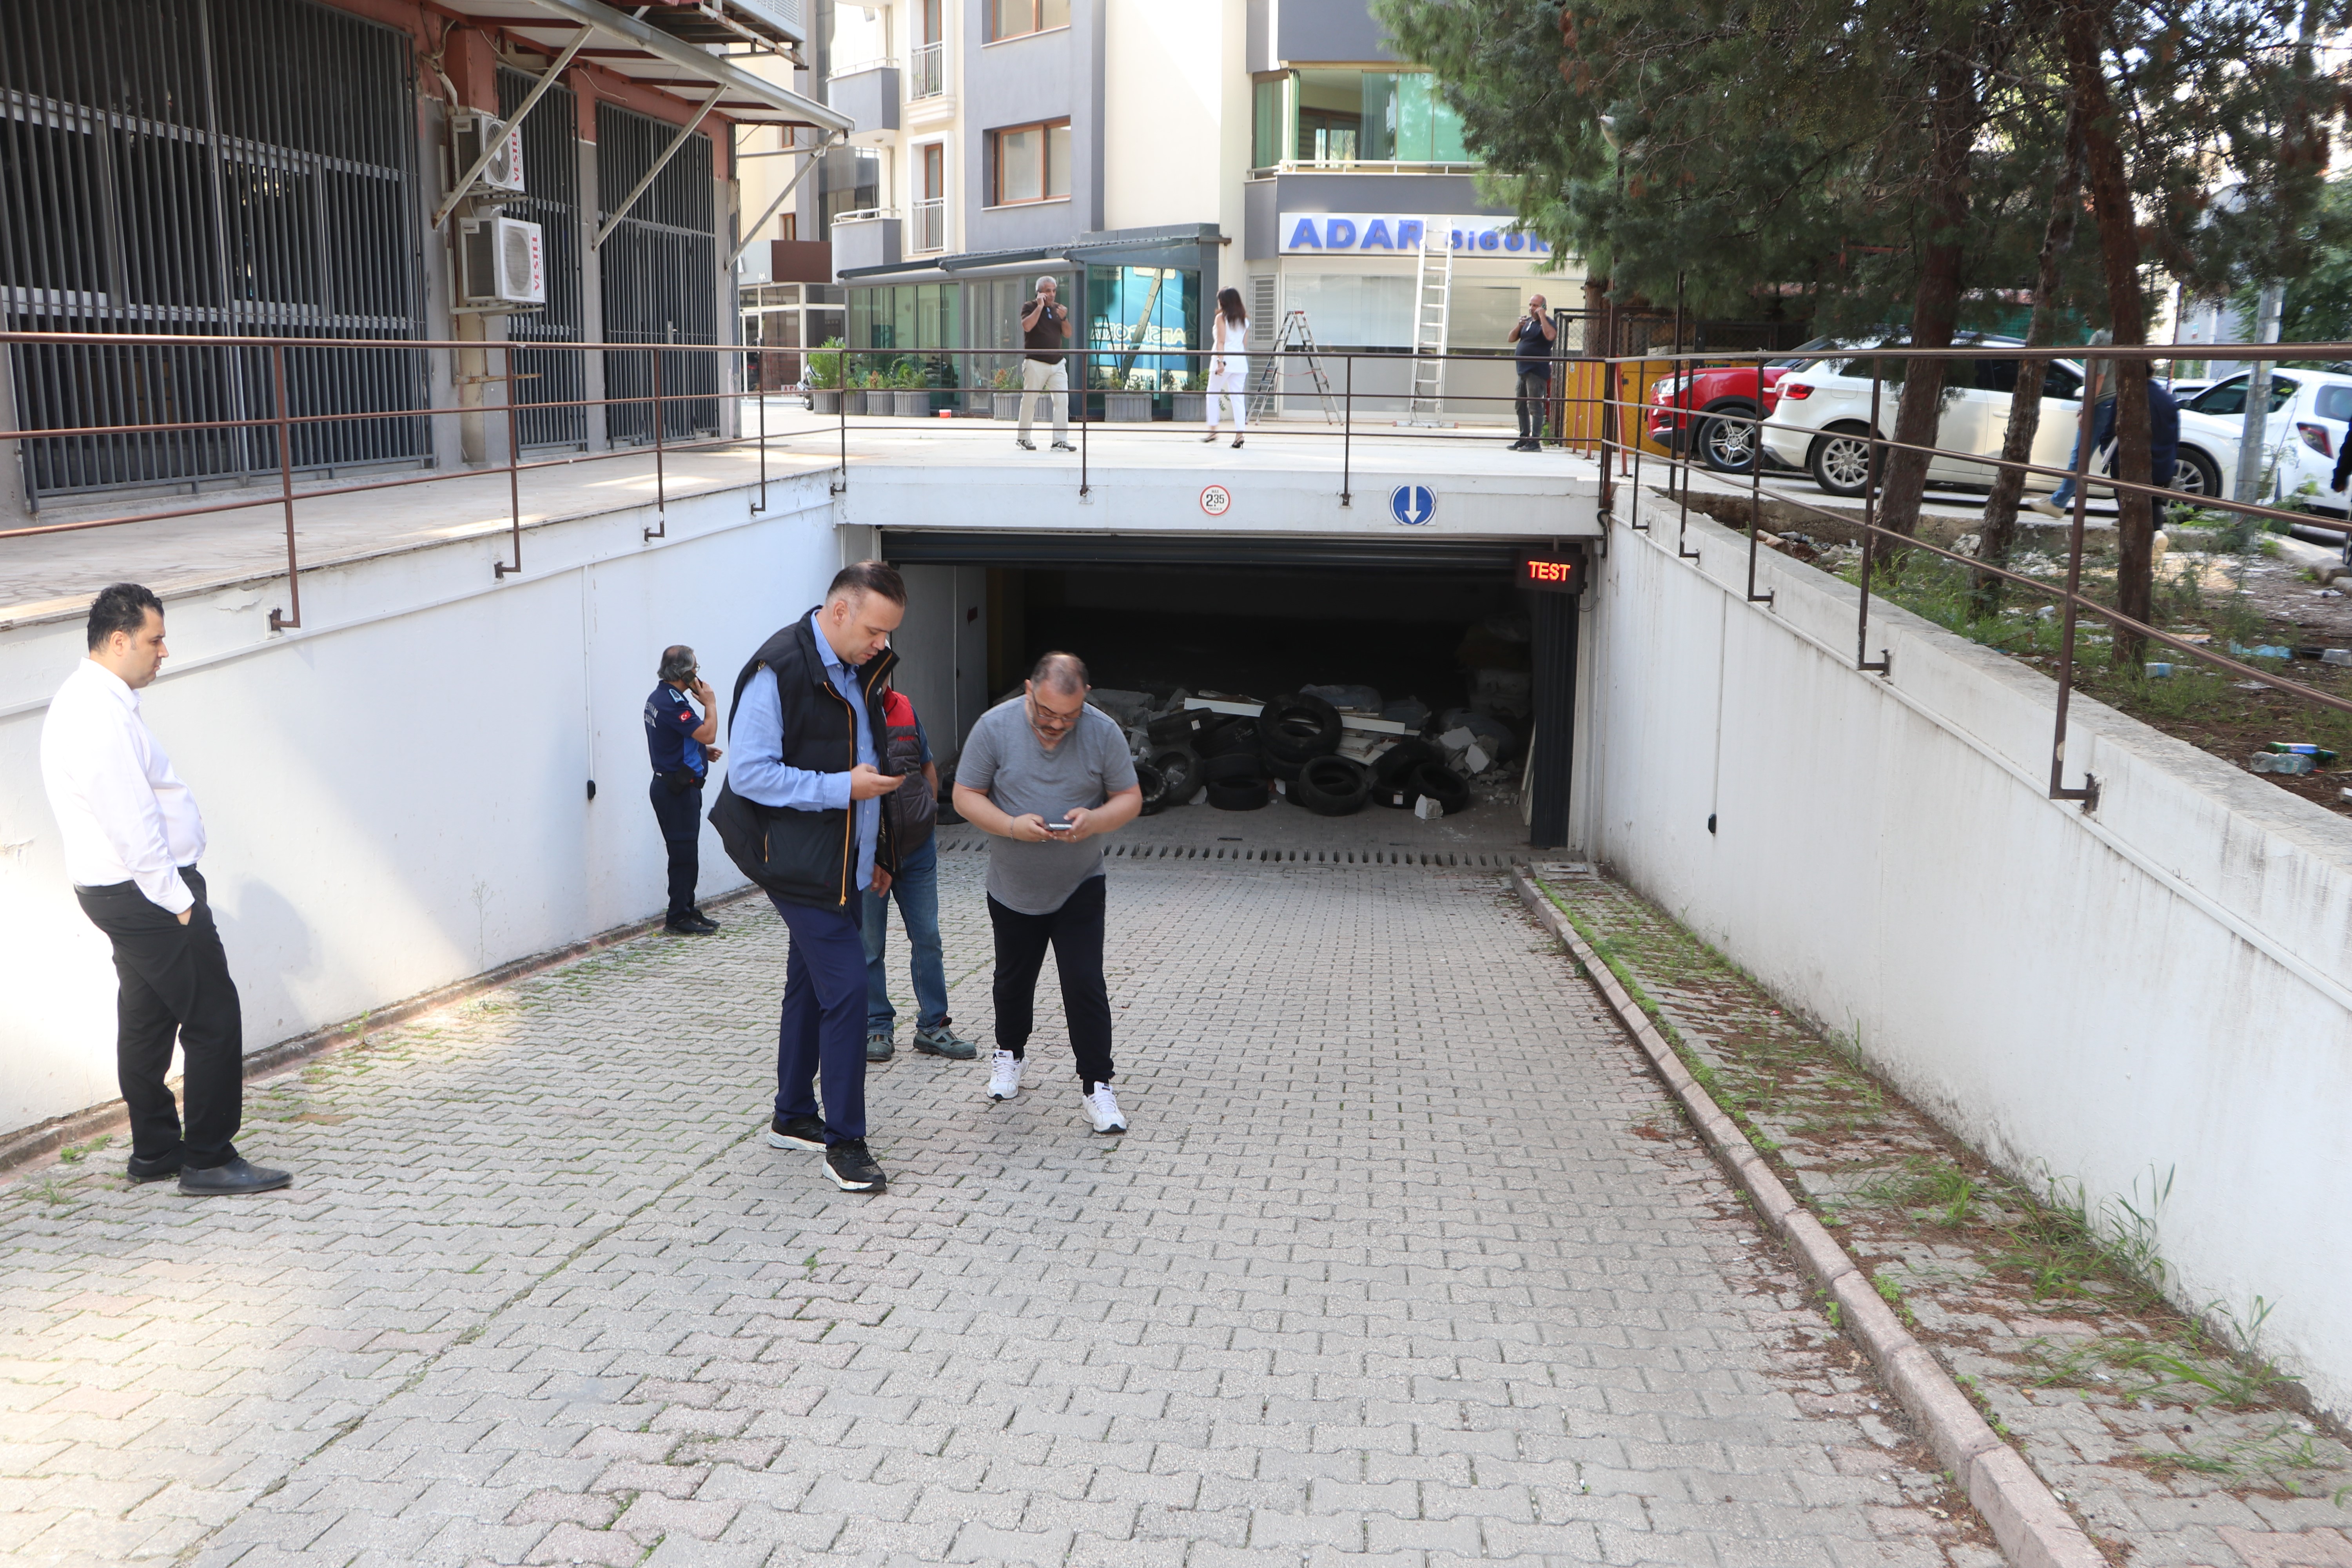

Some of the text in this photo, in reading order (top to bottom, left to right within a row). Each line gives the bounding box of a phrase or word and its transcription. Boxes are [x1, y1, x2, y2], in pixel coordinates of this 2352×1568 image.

[511, 129, 519, 182] VESTEL
[1289, 218, 1427, 249] ADAR
[532, 232, 540, 291] VESTEL
[1206, 494, 1225, 507] 2.35
[1528, 561, 1571, 581] TEST
